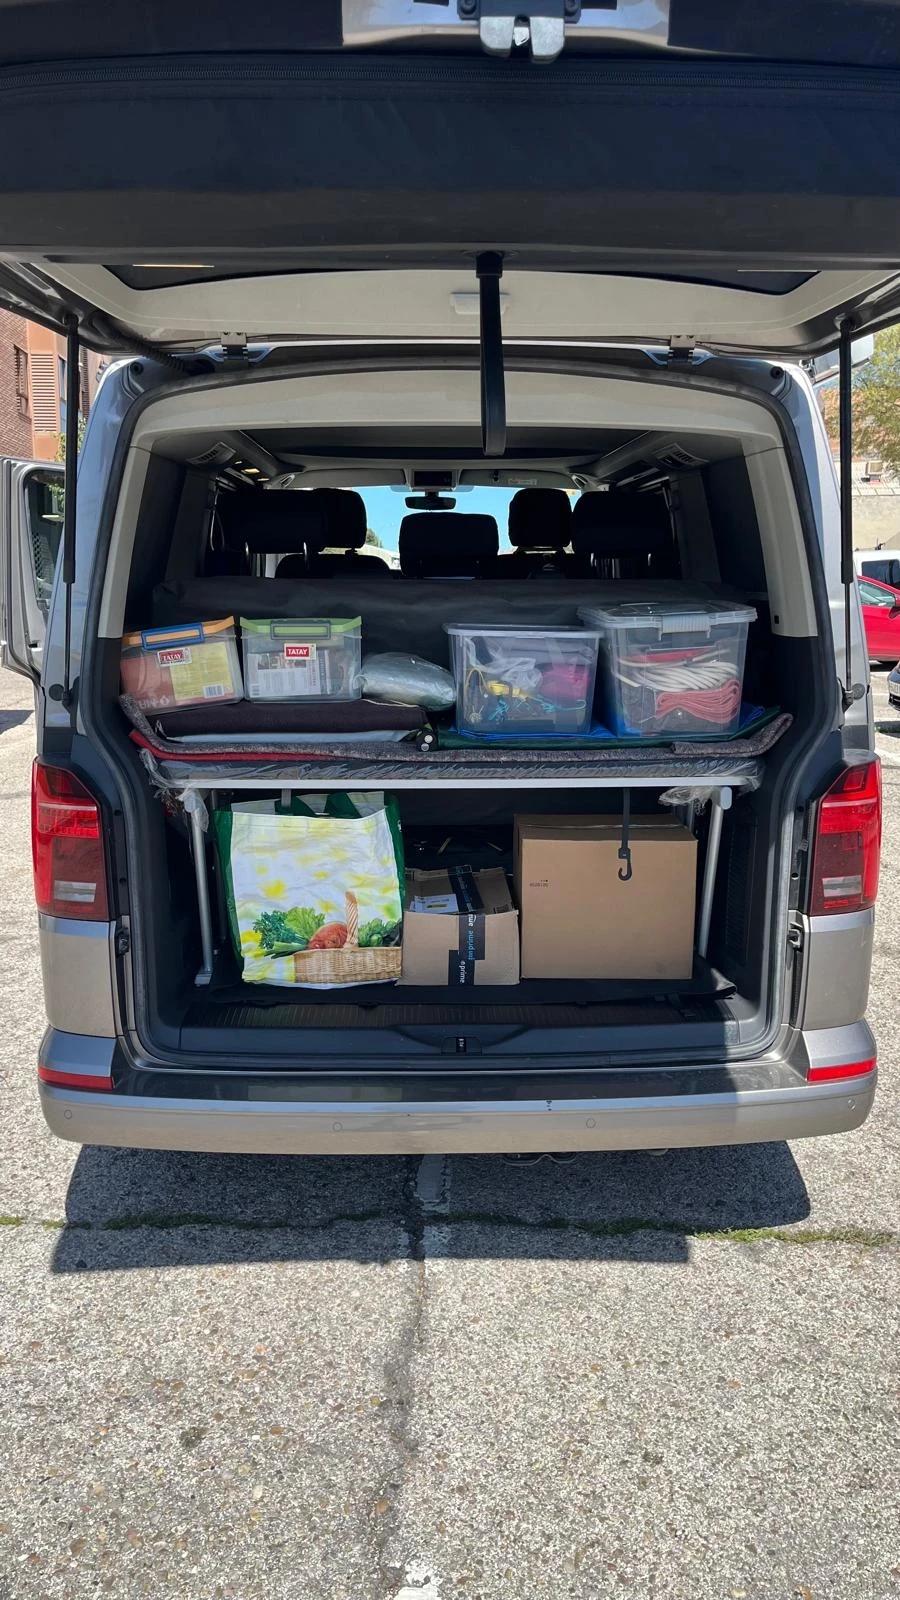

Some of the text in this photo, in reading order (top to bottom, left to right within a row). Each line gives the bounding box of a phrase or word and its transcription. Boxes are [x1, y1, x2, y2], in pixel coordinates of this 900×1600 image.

[161, 653, 182, 661] TATAY
[467, 930, 475, 950] prime
[459, 965, 467, 984] prime
